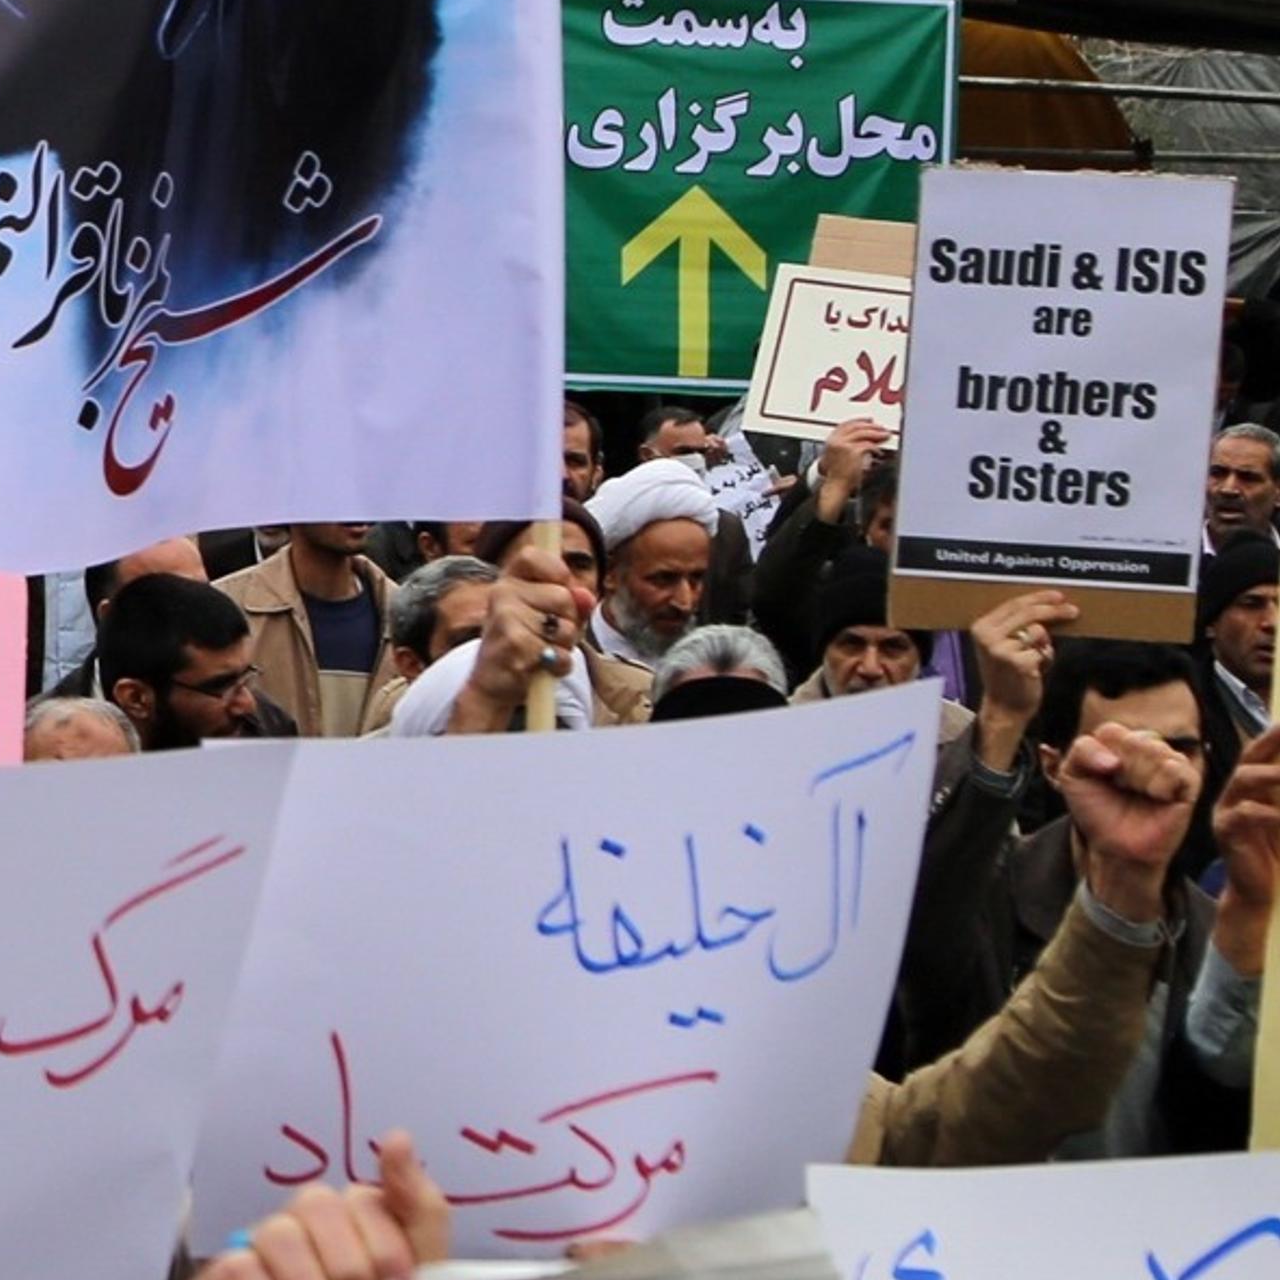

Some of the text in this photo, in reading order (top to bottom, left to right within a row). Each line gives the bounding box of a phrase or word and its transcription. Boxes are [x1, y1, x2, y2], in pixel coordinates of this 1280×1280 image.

[751, 2, 809, 71] به
[566, 87, 939, 179] محل برگزاری
[928, 237, 1208, 297] Saudi & ISIS
[1032, 302, 1093, 338] are
[956, 366, 1158, 422] brothers
[1038, 422, 1068, 455] &
[968, 456, 1131, 508] Sisters
[936, 548, 1151, 576] United Against Oppression
[535, 731, 917, 1028] آل خلیفه
